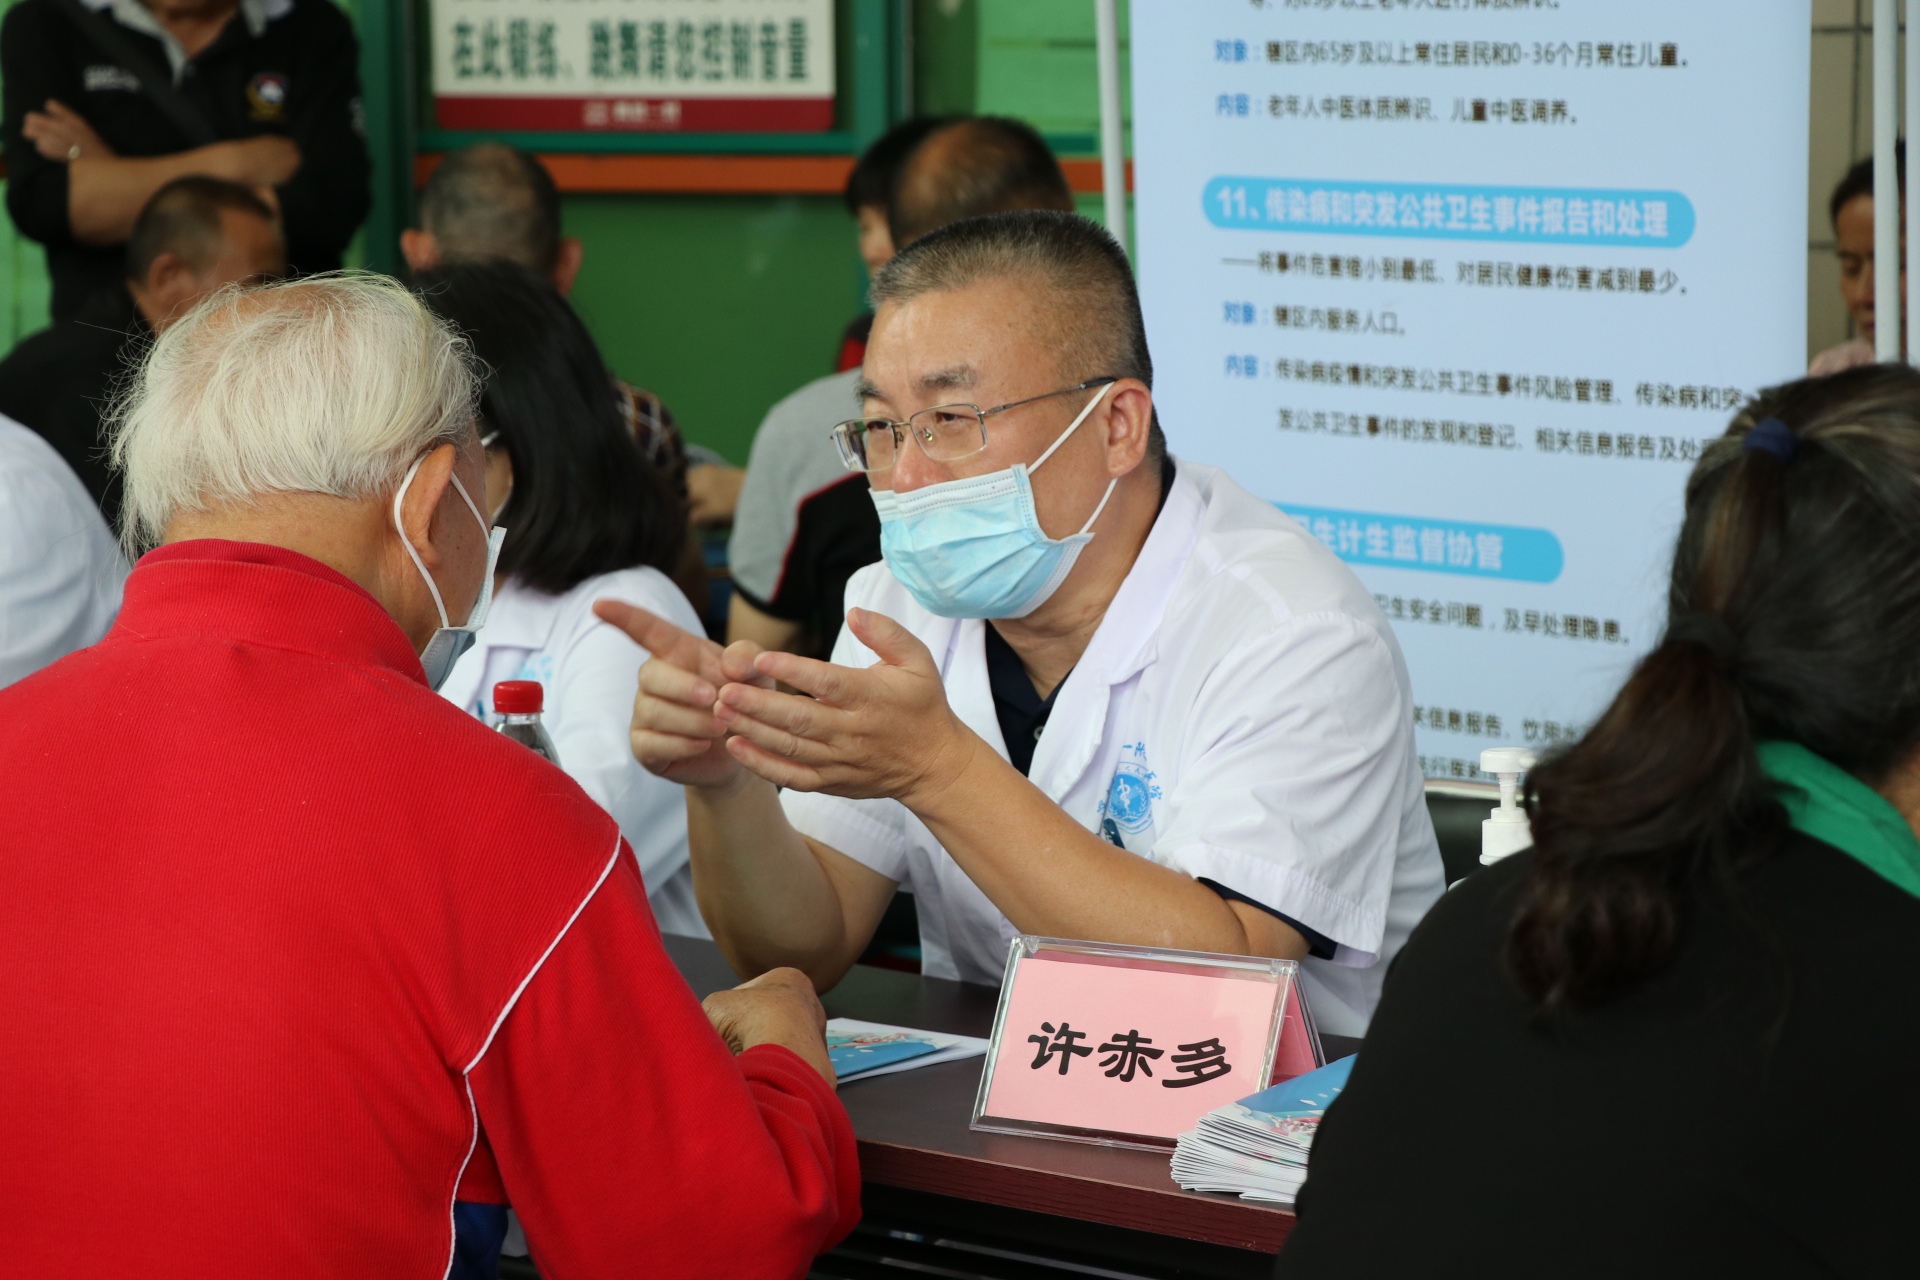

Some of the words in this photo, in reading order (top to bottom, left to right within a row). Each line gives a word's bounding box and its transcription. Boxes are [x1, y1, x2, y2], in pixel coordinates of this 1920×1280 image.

[1217, 185, 1669, 237] 11、传染病和突发公共卫生事件报告和处理
[1027, 1021, 1232, 1089] 许赤多
